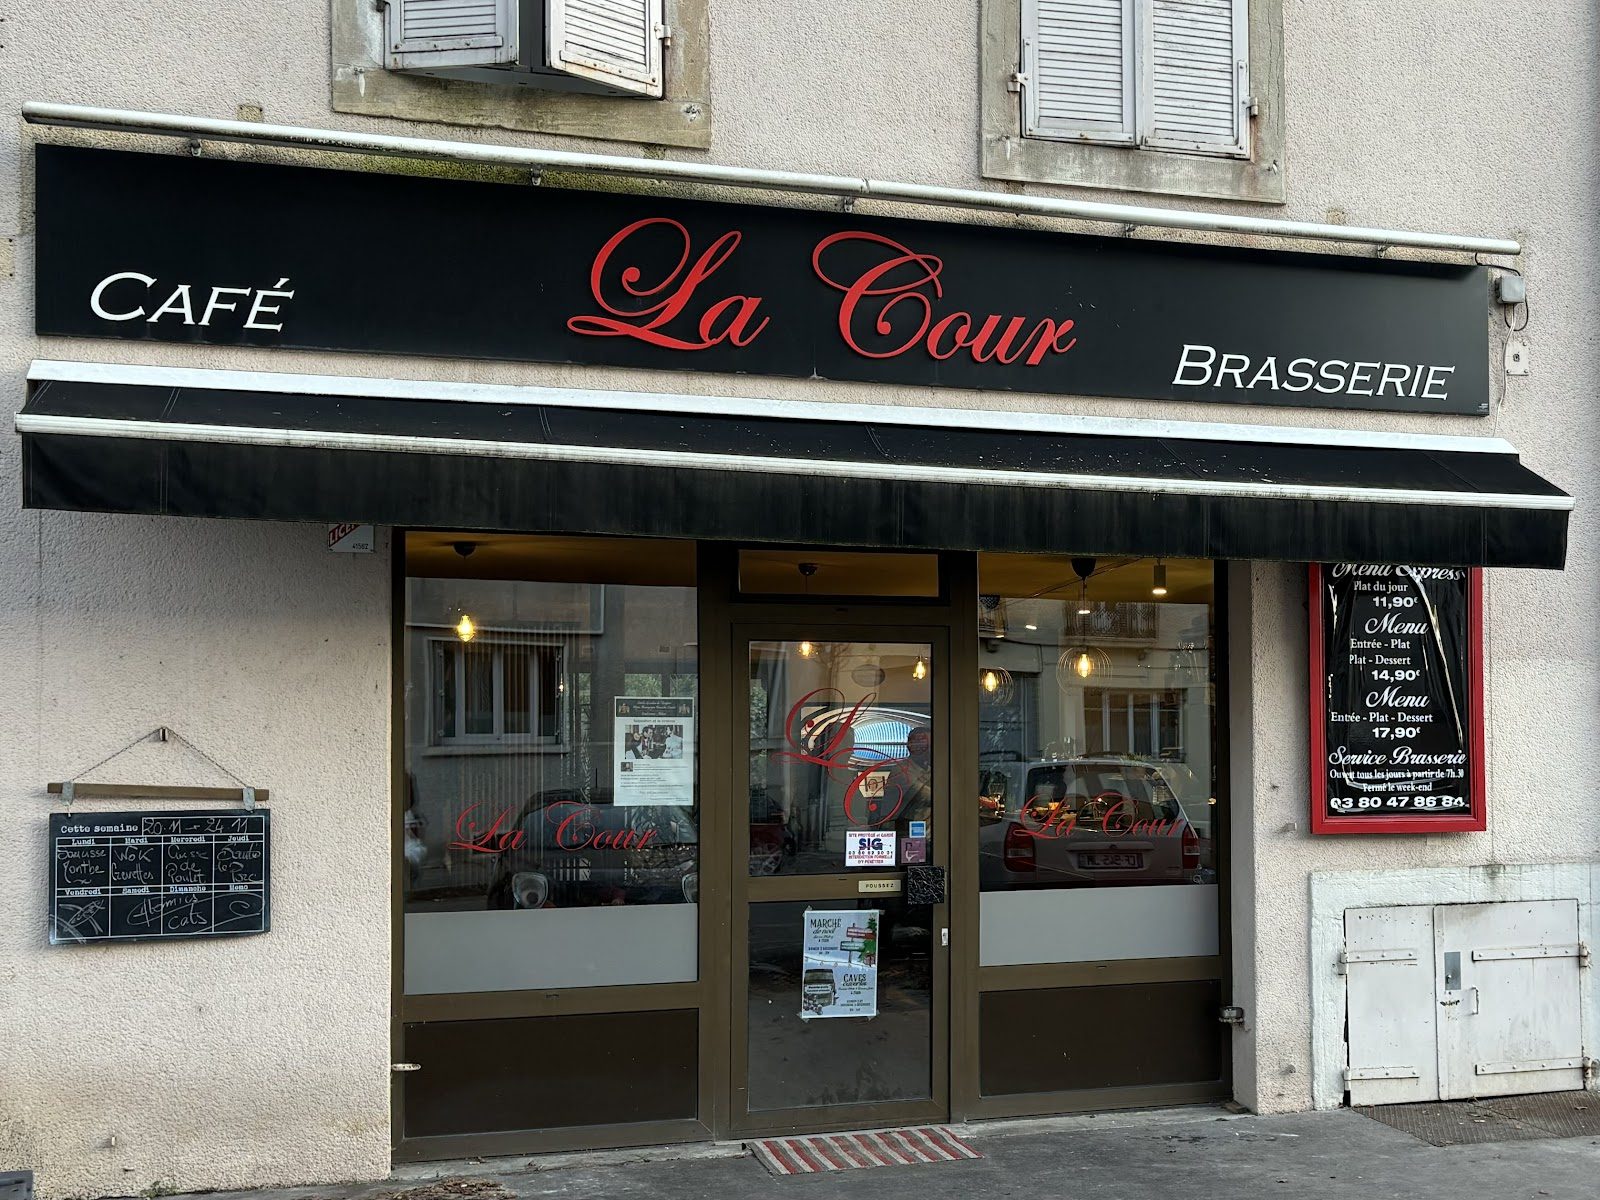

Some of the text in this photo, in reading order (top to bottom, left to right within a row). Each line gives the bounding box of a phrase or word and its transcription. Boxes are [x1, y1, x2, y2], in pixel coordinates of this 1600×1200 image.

[566, 217, 1077, 367] La Cour
[90, 271, 295, 332] CAFÉ
[1172, 344, 1455, 400] BRASSERIE
[1332, 563, 1393, 577] Menu
[1353, 581, 1408, 594] Plat du jour
[1364, 613, 1429, 635] Menu
[1350, 638, 1382, 649] Entrée
[1390, 639, 1411, 649] Plat
[1349, 654, 1366, 665] Plat
[1375, 654, 1411, 665] Dessert
[1365, 686, 1430, 707] Menu
[1331, 711, 1360, 723] Entrée
[1369, 712, 1389, 722] Plat
[1397, 712, 1433, 722] Dessert
[1328, 745, 1467, 765] Service Brasserie
[1357, 770, 1372, 779] tous
[1374, 768, 1384, 779] les
[1385, 768, 1405, 781] jours
[1412, 768, 1434, 780] partir
[1435, 768, 1445, 778] de
[1362, 781, 1432, 792] Fermé le week-end
[1330, 795, 1465, 808] 03 80 47 86 84
[1013, 792, 1184, 839] La Cour
[60, 823, 138, 834] Cette semaine
[447, 800, 657, 853] La Cour
[858, 838, 883, 850] SIG
[122, 886, 150, 894] Samedi
